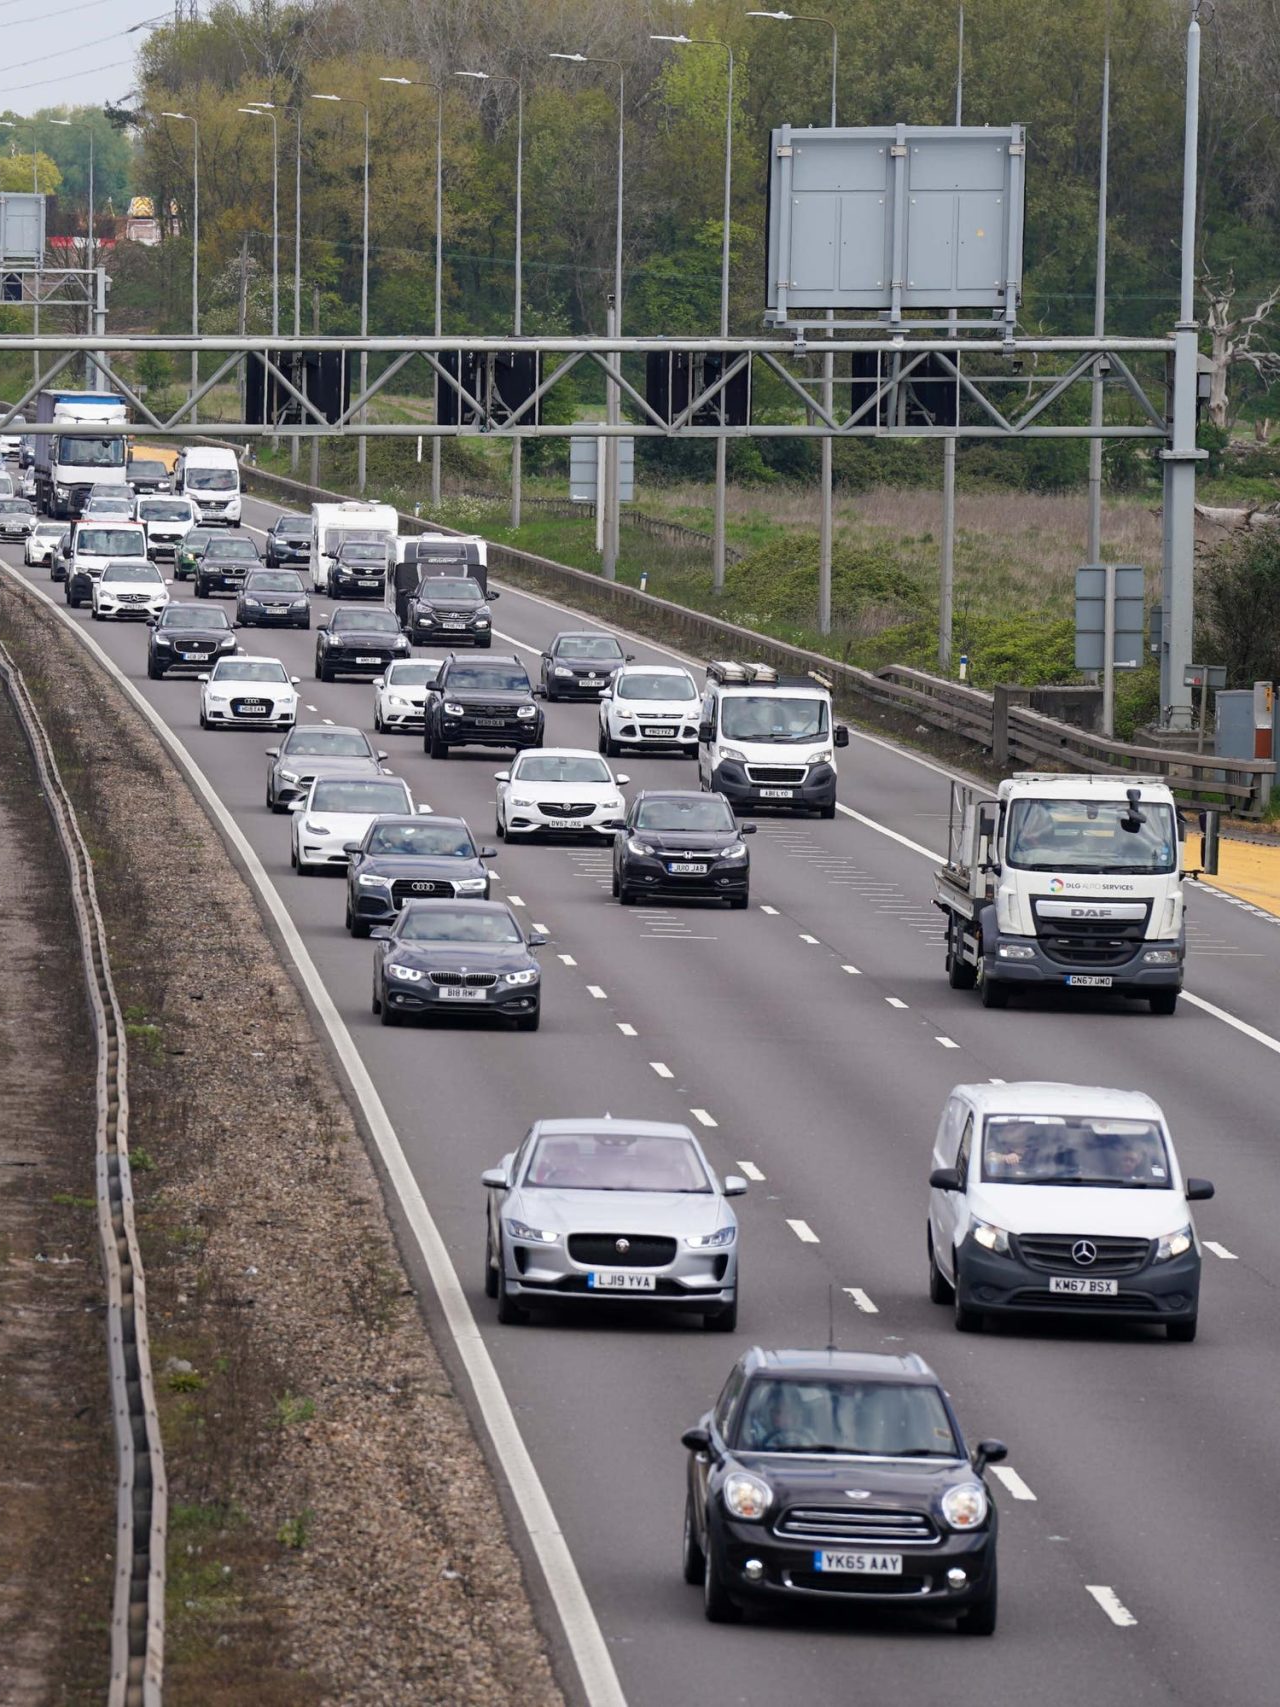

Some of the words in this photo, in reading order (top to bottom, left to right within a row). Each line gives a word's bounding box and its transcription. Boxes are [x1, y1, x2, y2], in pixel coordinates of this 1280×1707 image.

[1071, 908, 1112, 917] DAF
[1072, 976, 1094, 985] GN67
[598, 1275, 625, 1286] LJ19
[629, 1276, 651, 1287] YVA
[1090, 1281, 1112, 1293] BSX
[825, 1554, 866, 1569] YK65
[870, 1556, 900, 1572] AAY
